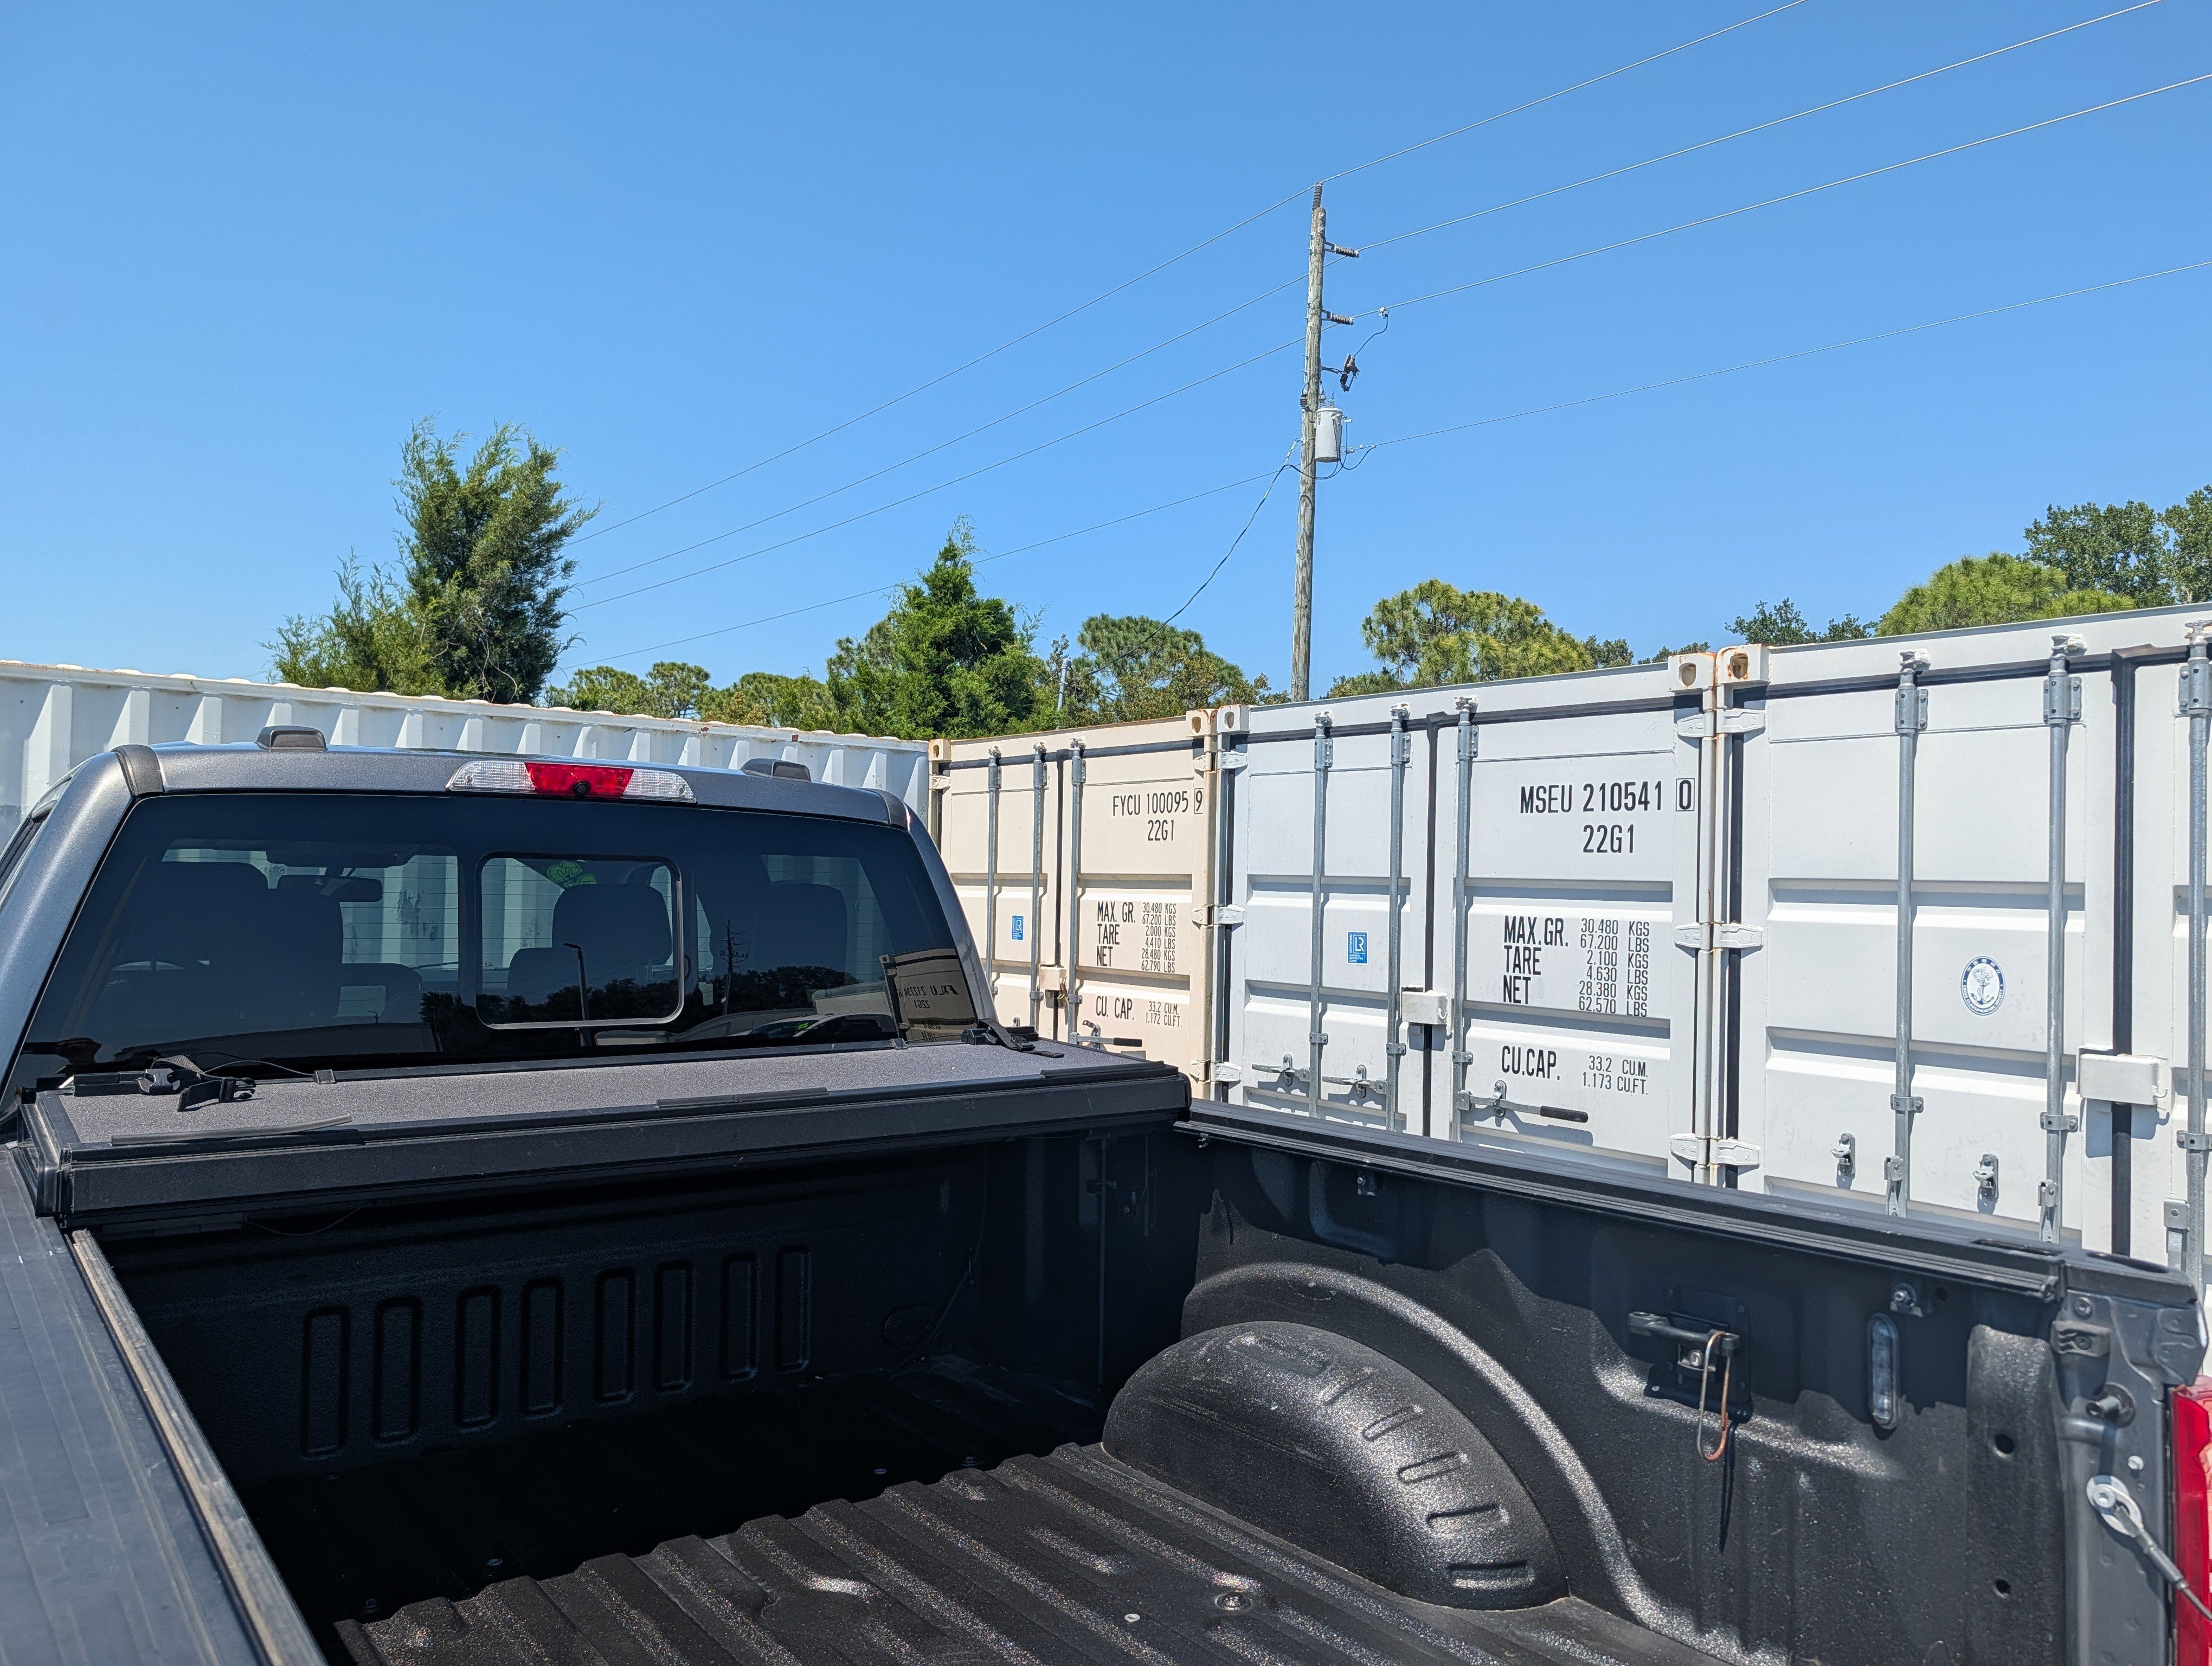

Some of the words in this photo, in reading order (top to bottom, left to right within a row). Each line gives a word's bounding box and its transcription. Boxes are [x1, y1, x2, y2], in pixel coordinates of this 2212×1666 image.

[1113, 794, 1140, 816] FYCU
[1147, 791, 1188, 815] 100095
[1195, 790, 1203, 812] 9
[1520, 785, 1572, 813] MSEU
[1583, 780, 1662, 812] 210541
[1679, 780, 1691, 810] 0
[1147, 819, 1174, 841] 22G1
[1583, 824, 1634, 853] 22G1
[1097, 901, 1117, 922] MAX.
[1122, 902, 1135, 923] GR.
[1165, 903, 1176, 914] KGS
[1165, 915, 1176, 926] LBS
[1097, 924, 1120, 945] TARE
[1165, 926, 1176, 938] KGS
[1629, 921, 1649, 937] KGS
[1164, 938, 1175, 949] LBS
[1628, 937, 1649, 952] LBS
[1096, 946, 1113, 967] NET
[1164, 950, 1175, 961] KGS
[1504, 945, 1541, 975] TARE
[1628, 953, 1648, 969] KGS
[1163, 962, 1175, 973] LBS
[1627, 969, 1648, 985] LBS
[1503, 975, 1531, 1004] NET
[1627, 985, 1648, 1001] KGS
[1096, 995, 1108, 1017] CU.
[1114, 997, 1134, 1020] CAP.
[1149, 1001, 1161, 1013] 33.2
[1626, 1001, 1647, 1017] LBS
[1589, 1055, 1612, 1072] 33.2
